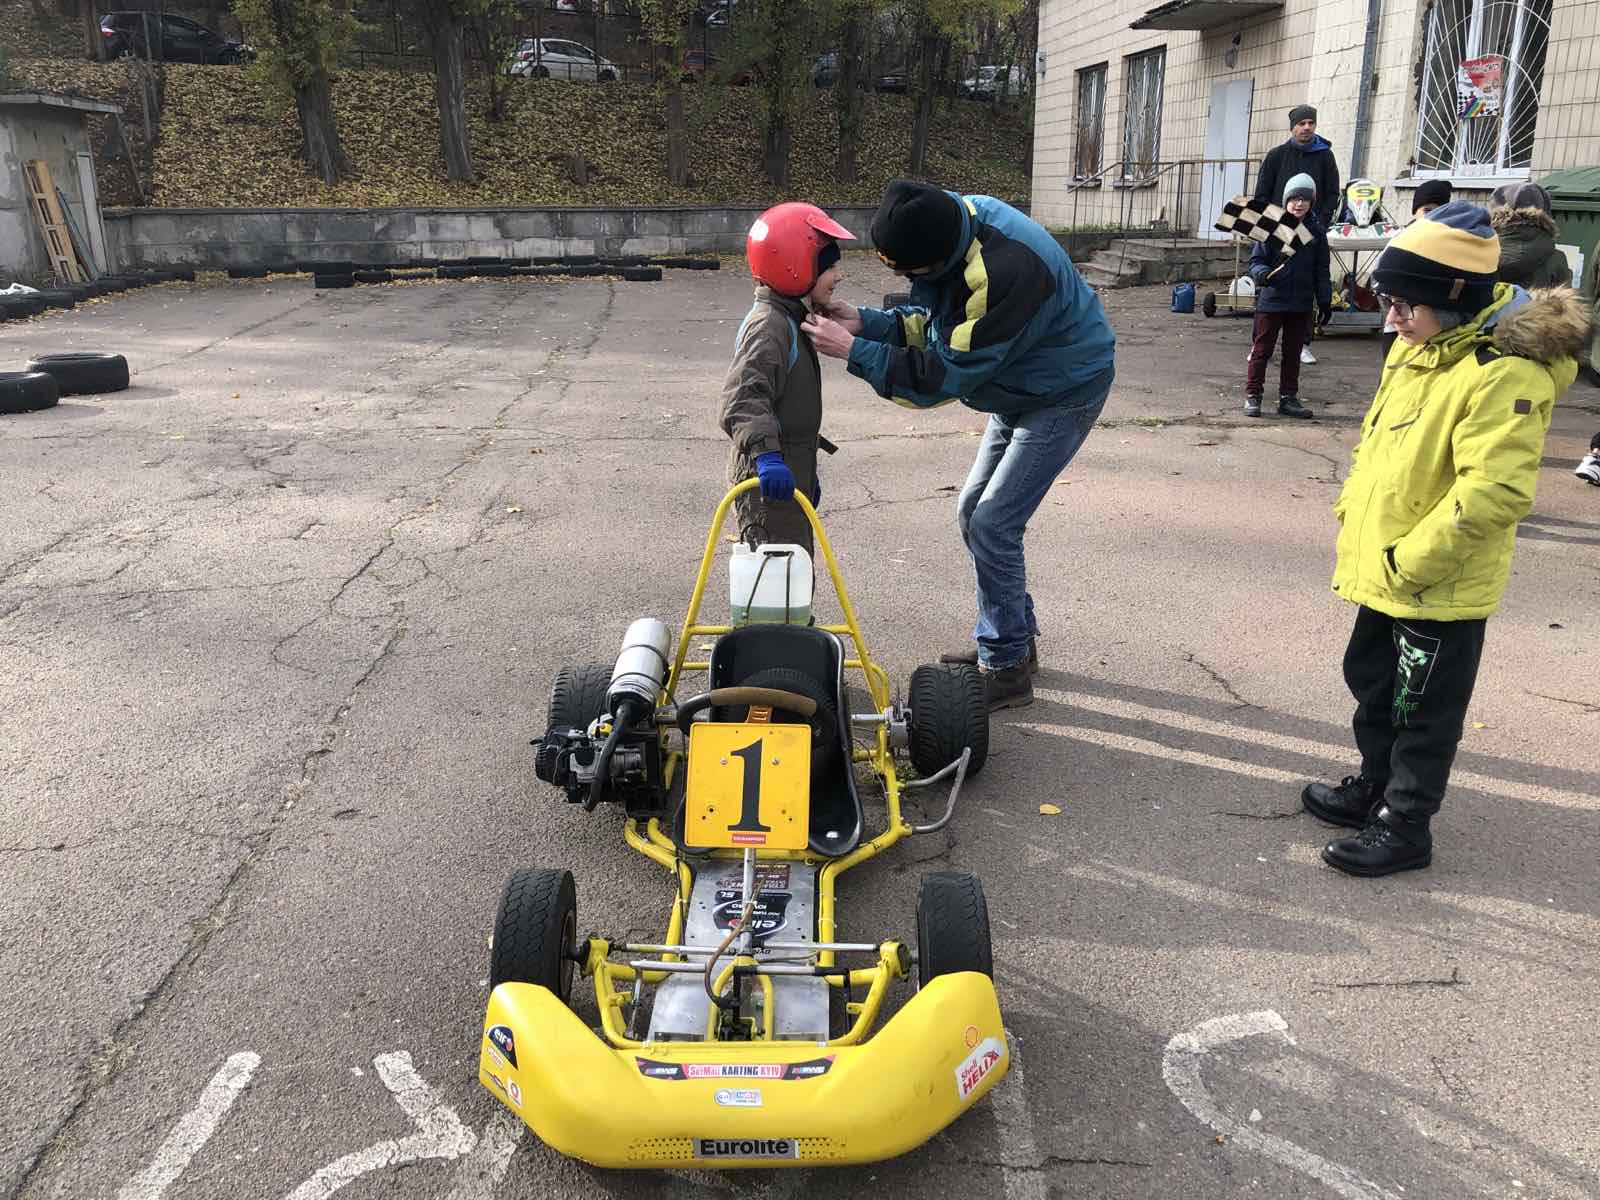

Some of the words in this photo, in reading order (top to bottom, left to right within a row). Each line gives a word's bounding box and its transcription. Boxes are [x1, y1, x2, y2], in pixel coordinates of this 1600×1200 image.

[727, 736, 772, 833] 1
[721, 1065, 759, 1077] KARTING
[760, 1065, 780, 1077] KYIV
[962, 1050, 1000, 1095] HELIX
[700, 1139, 790, 1156] Eurolite
